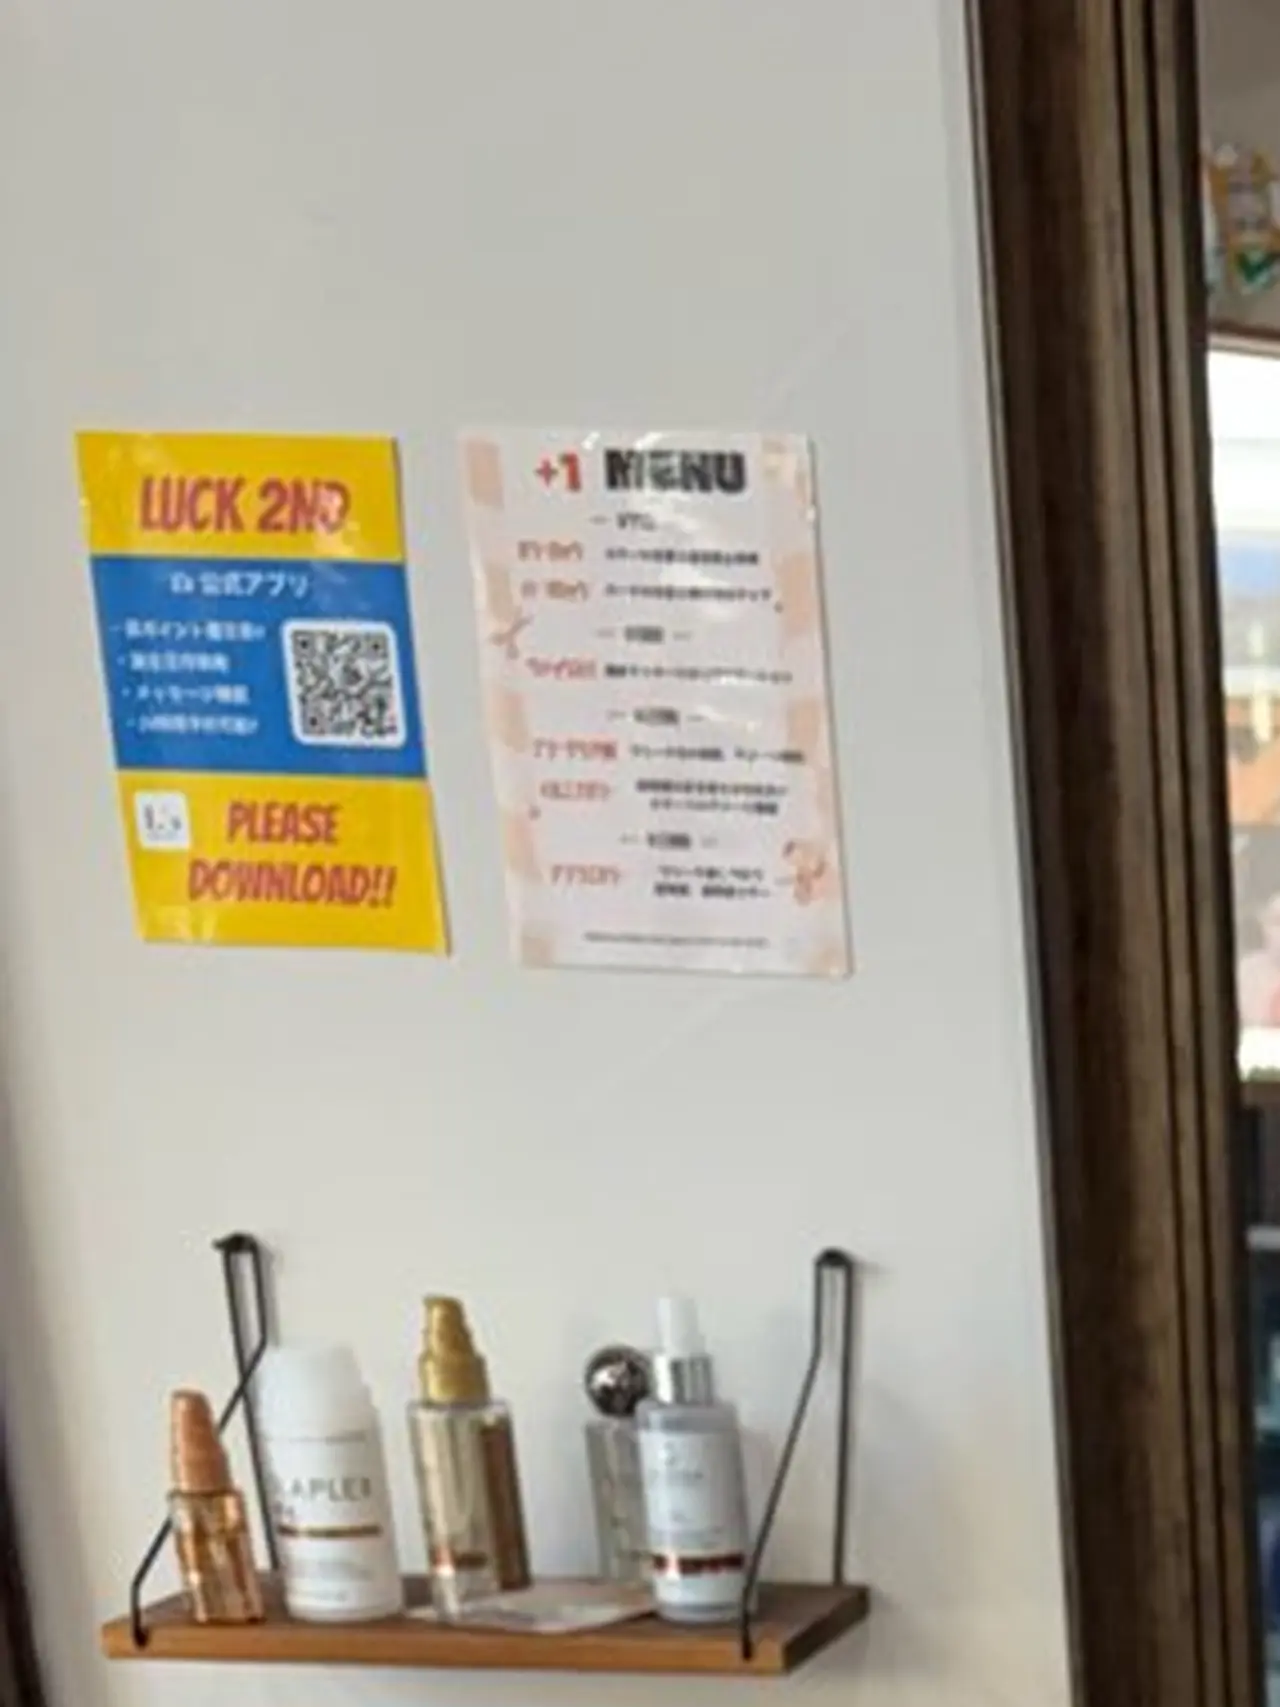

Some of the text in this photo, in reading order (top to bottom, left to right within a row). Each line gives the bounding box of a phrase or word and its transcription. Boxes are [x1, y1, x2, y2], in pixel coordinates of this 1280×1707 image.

[534, 449, 746, 495] +1 MENU
[140, 475, 350, 535] LUCK 2ND
[226, 800, 340, 846] PLEASE
[187, 860, 397, 909] DOWNLOAD!!
